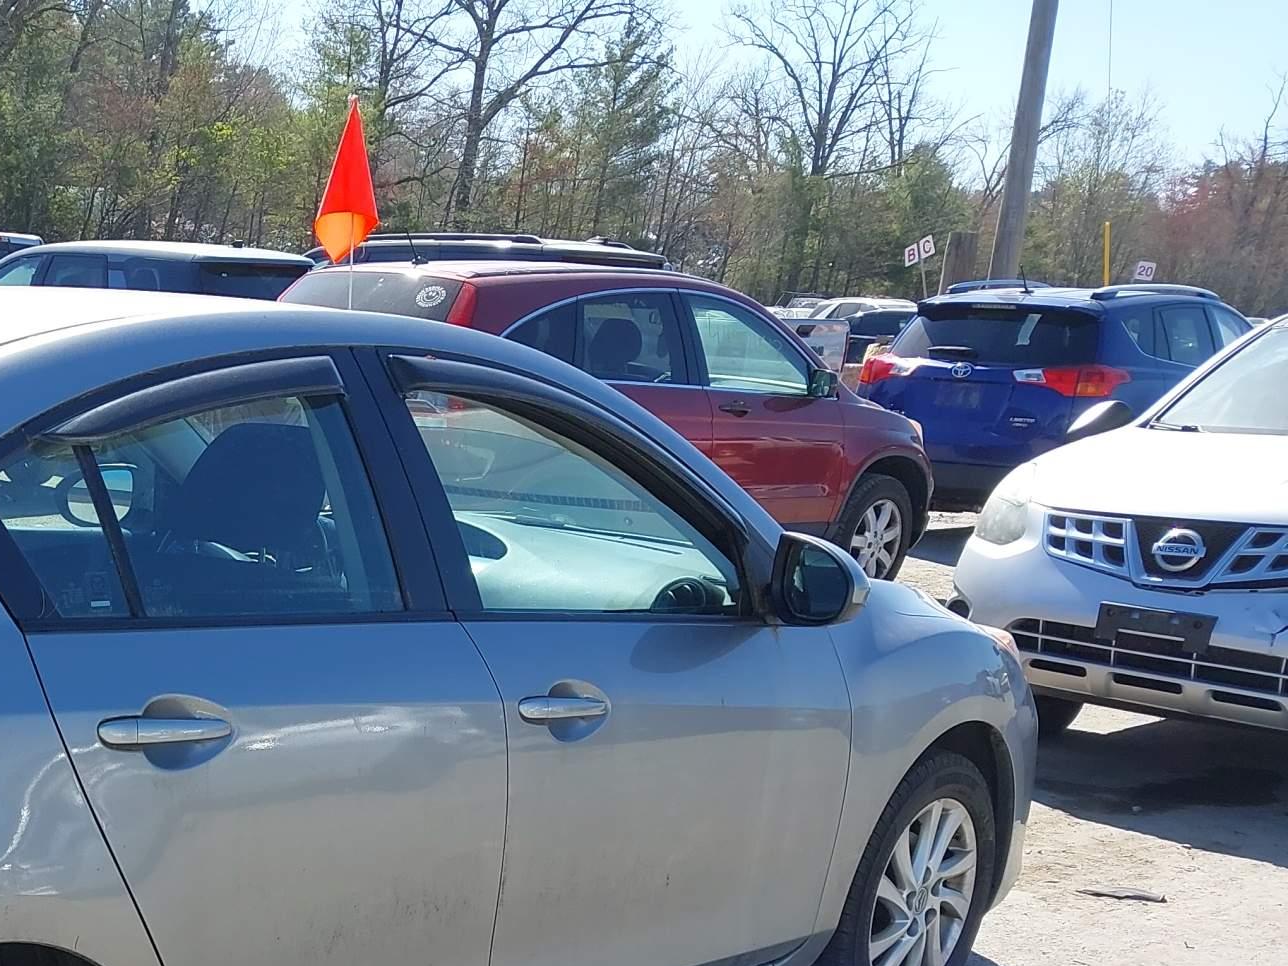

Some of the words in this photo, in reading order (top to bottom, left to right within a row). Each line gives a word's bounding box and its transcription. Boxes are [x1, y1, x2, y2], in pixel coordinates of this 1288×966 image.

[922, 239, 932, 254] C
[907, 248, 916, 263] B
[1137, 265, 1154, 277] 20
[1156, 545, 1199, 554] NISSAN
